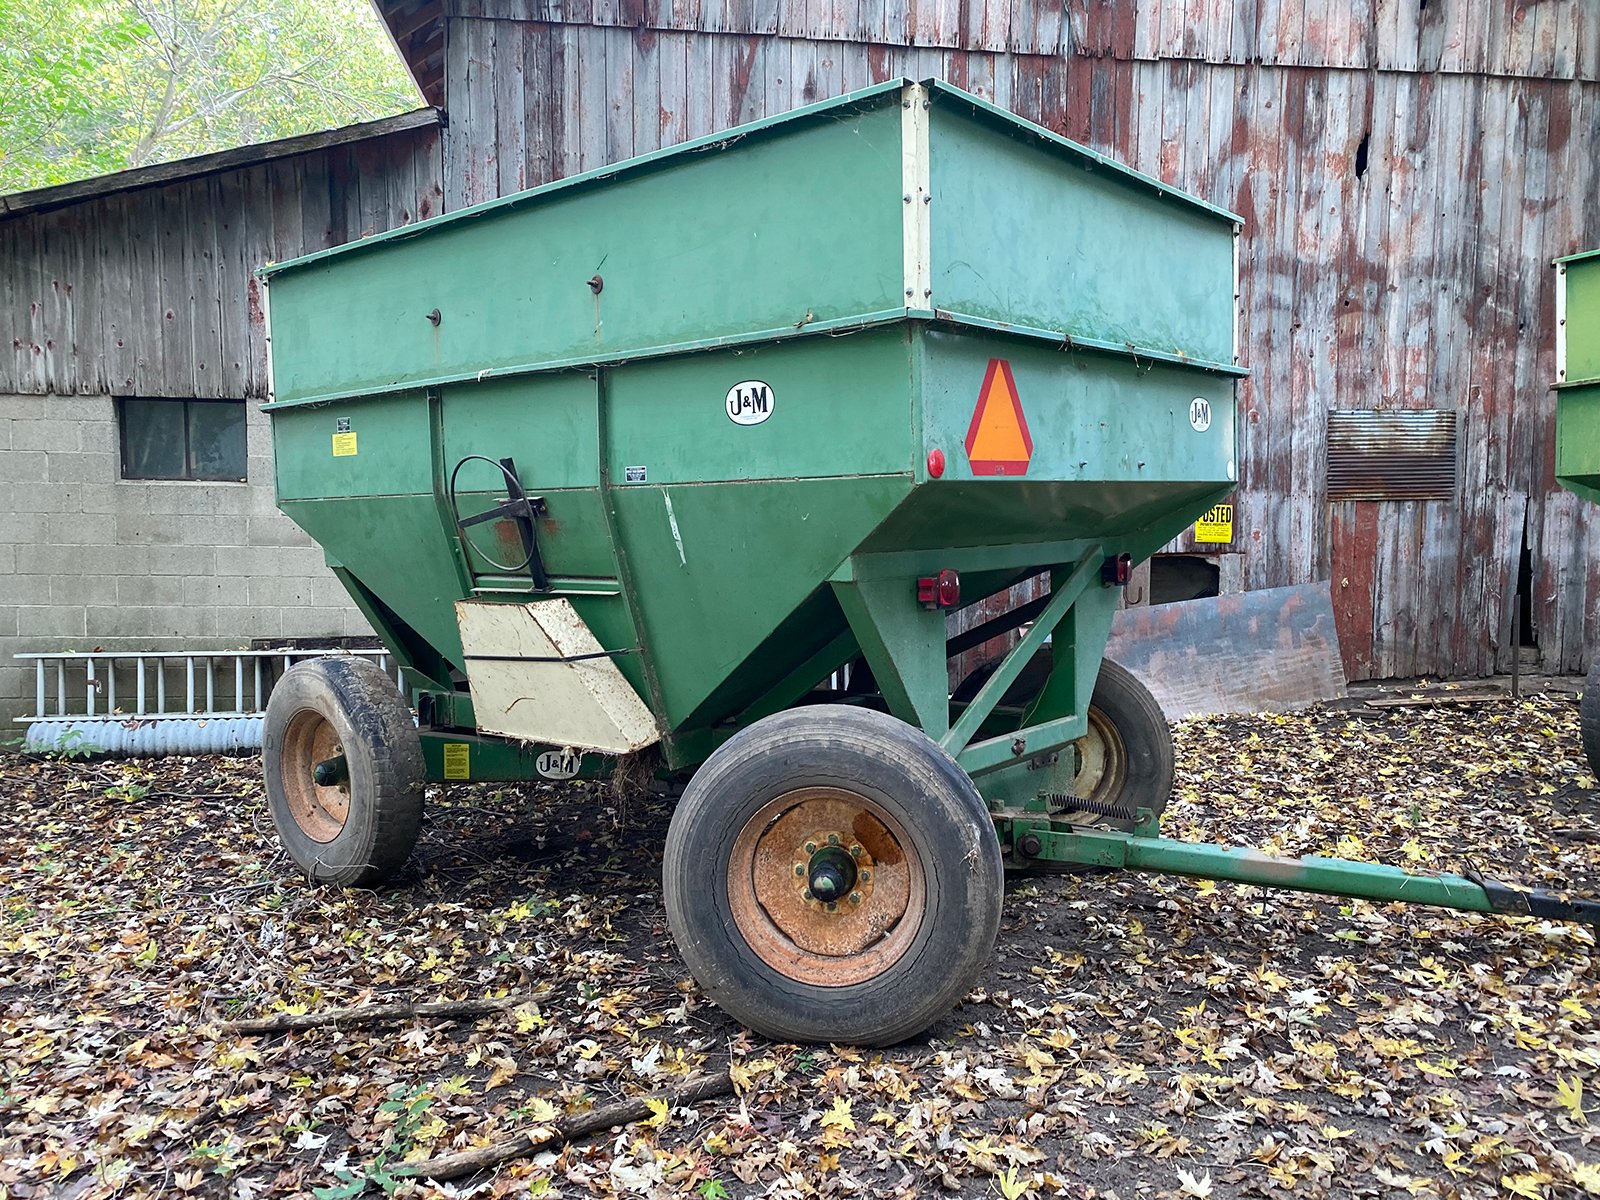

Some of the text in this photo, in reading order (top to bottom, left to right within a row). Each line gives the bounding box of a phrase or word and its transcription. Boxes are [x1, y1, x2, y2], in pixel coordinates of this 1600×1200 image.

[729, 386, 768, 416] J&M
[1191, 402, 1208, 424] J&M
[1197, 506, 1231, 523] OSTED
[539, 754, 574, 773] J&M
